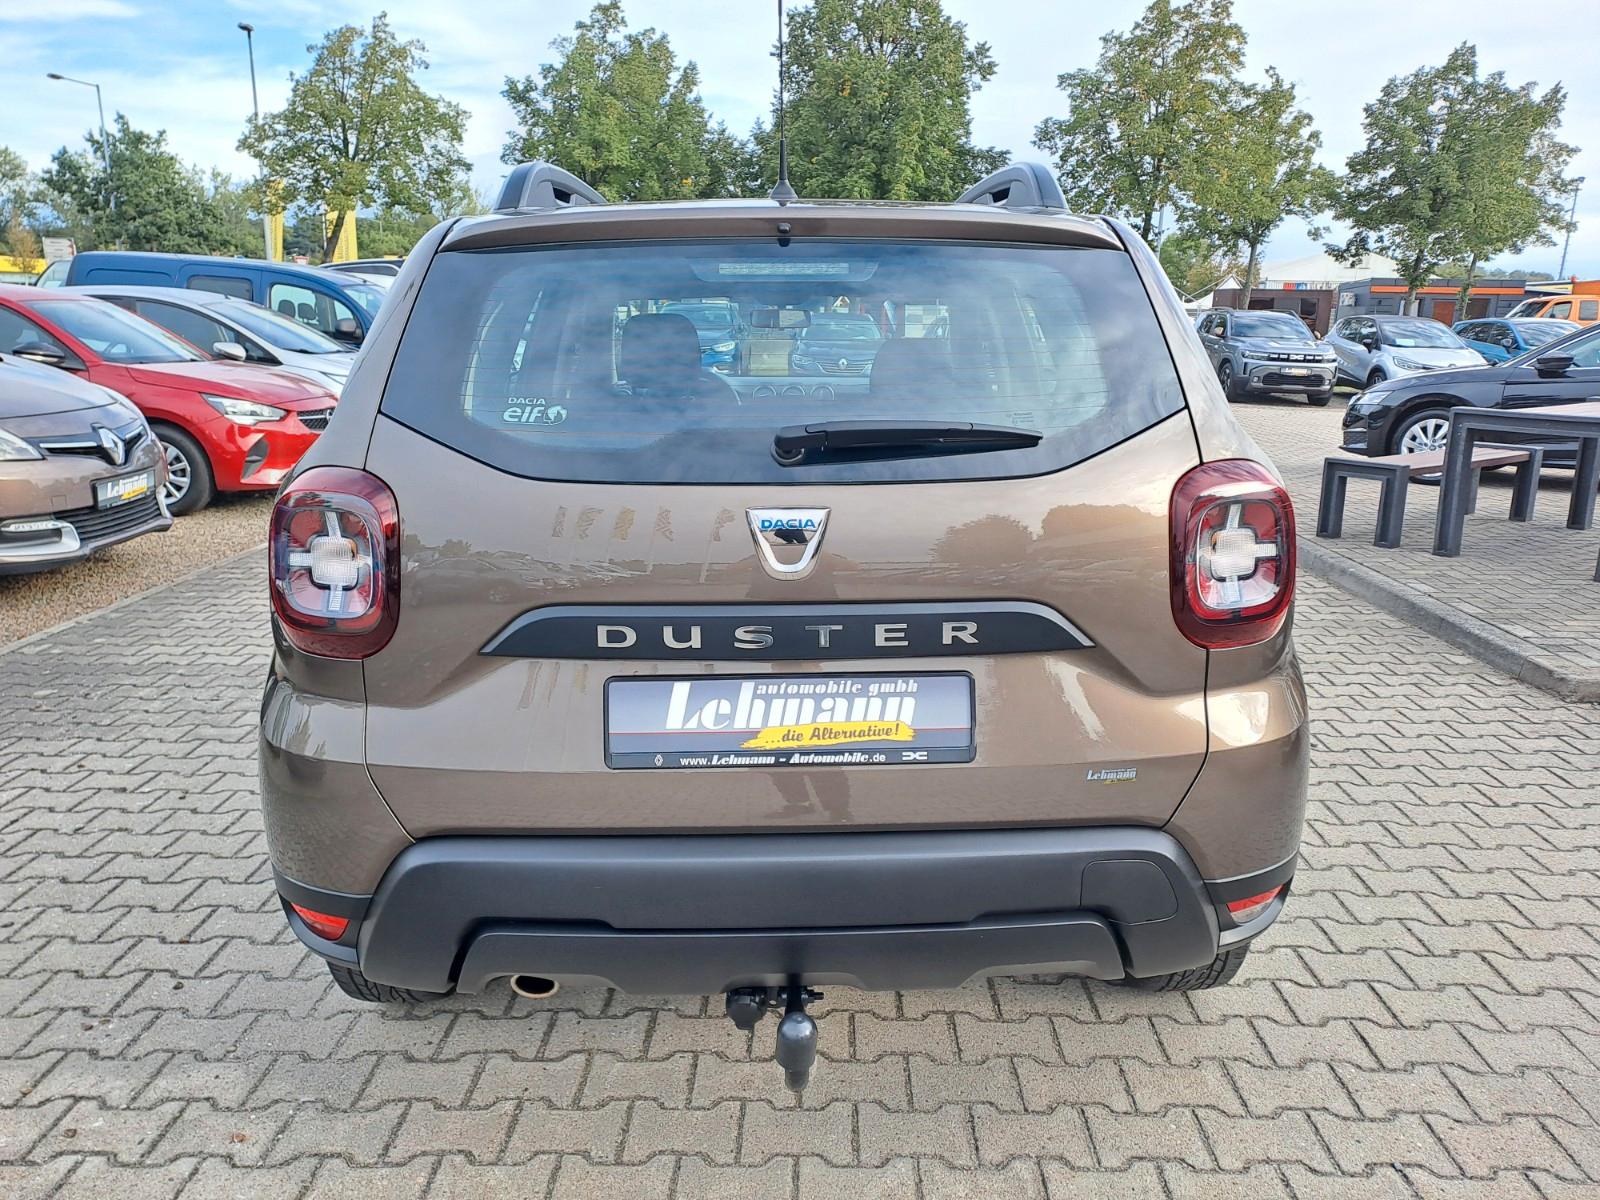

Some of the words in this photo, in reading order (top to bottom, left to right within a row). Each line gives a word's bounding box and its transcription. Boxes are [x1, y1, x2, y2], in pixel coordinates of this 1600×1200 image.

[508, 397, 546, 405] DACIA
[503, 406, 545, 423] elf
[761, 519, 816, 529] DACIA
[596, 621, 979, 649] DUSTER
[756, 681, 862, 695] automobile
[868, 679, 918, 697] gmbh
[665, 681, 916, 730] Lehmann
[809, 723, 899, 741] Alternative!
[680, 754, 776, 766] www.Lehmann
[789, 752, 886, 764] Automobile.de
